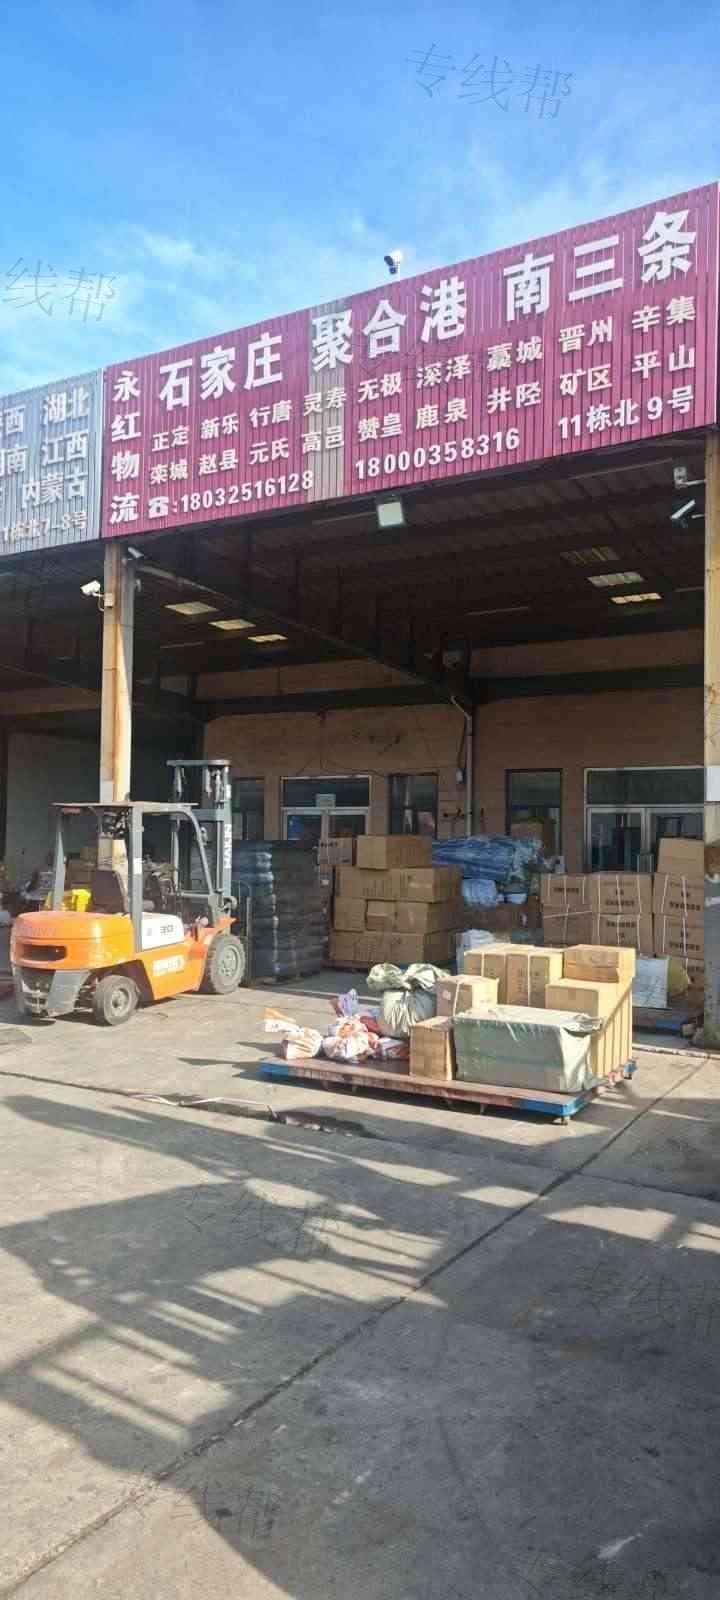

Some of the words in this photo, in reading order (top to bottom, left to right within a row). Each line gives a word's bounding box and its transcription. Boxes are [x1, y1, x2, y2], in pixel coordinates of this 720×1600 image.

[160, 333, 282, 410] 石家庄
[312, 276, 467, 373] 聚合港
[504, 209, 696, 322] 南三条
[43, 387, 90, 426] 湖北
[152, 425, 189, 452] 正定
[201, 413, 239, 440] 新乐
[249, 400, 292, 428] 行唐
[303, 387, 347, 416] 灵寿
[358, 372, 402, 403] 无极
[416, 354, 471, 389] 深泽
[559, 317, 613, 353] 晋州
[632, 296, 696, 333] 辛集
[199, 449, 239, 476] 赵县
[249, 438, 289, 465] 元氏
[302, 426, 345, 454] 高邑
[358, 412, 403, 442] 赞皇
[416, 398, 468, 430] 鹿泉
[487, 382, 542, 414] 井陉
[559, 364, 612, 396] 矿区
[632, 345, 695, 379] 平山
[22, 467, 87, 509] 内蒙古
[41, 429, 89, 467] 江西
[110, 371, 142, 524] 永红物流
[355, 429, 519, 481] 18000358316
